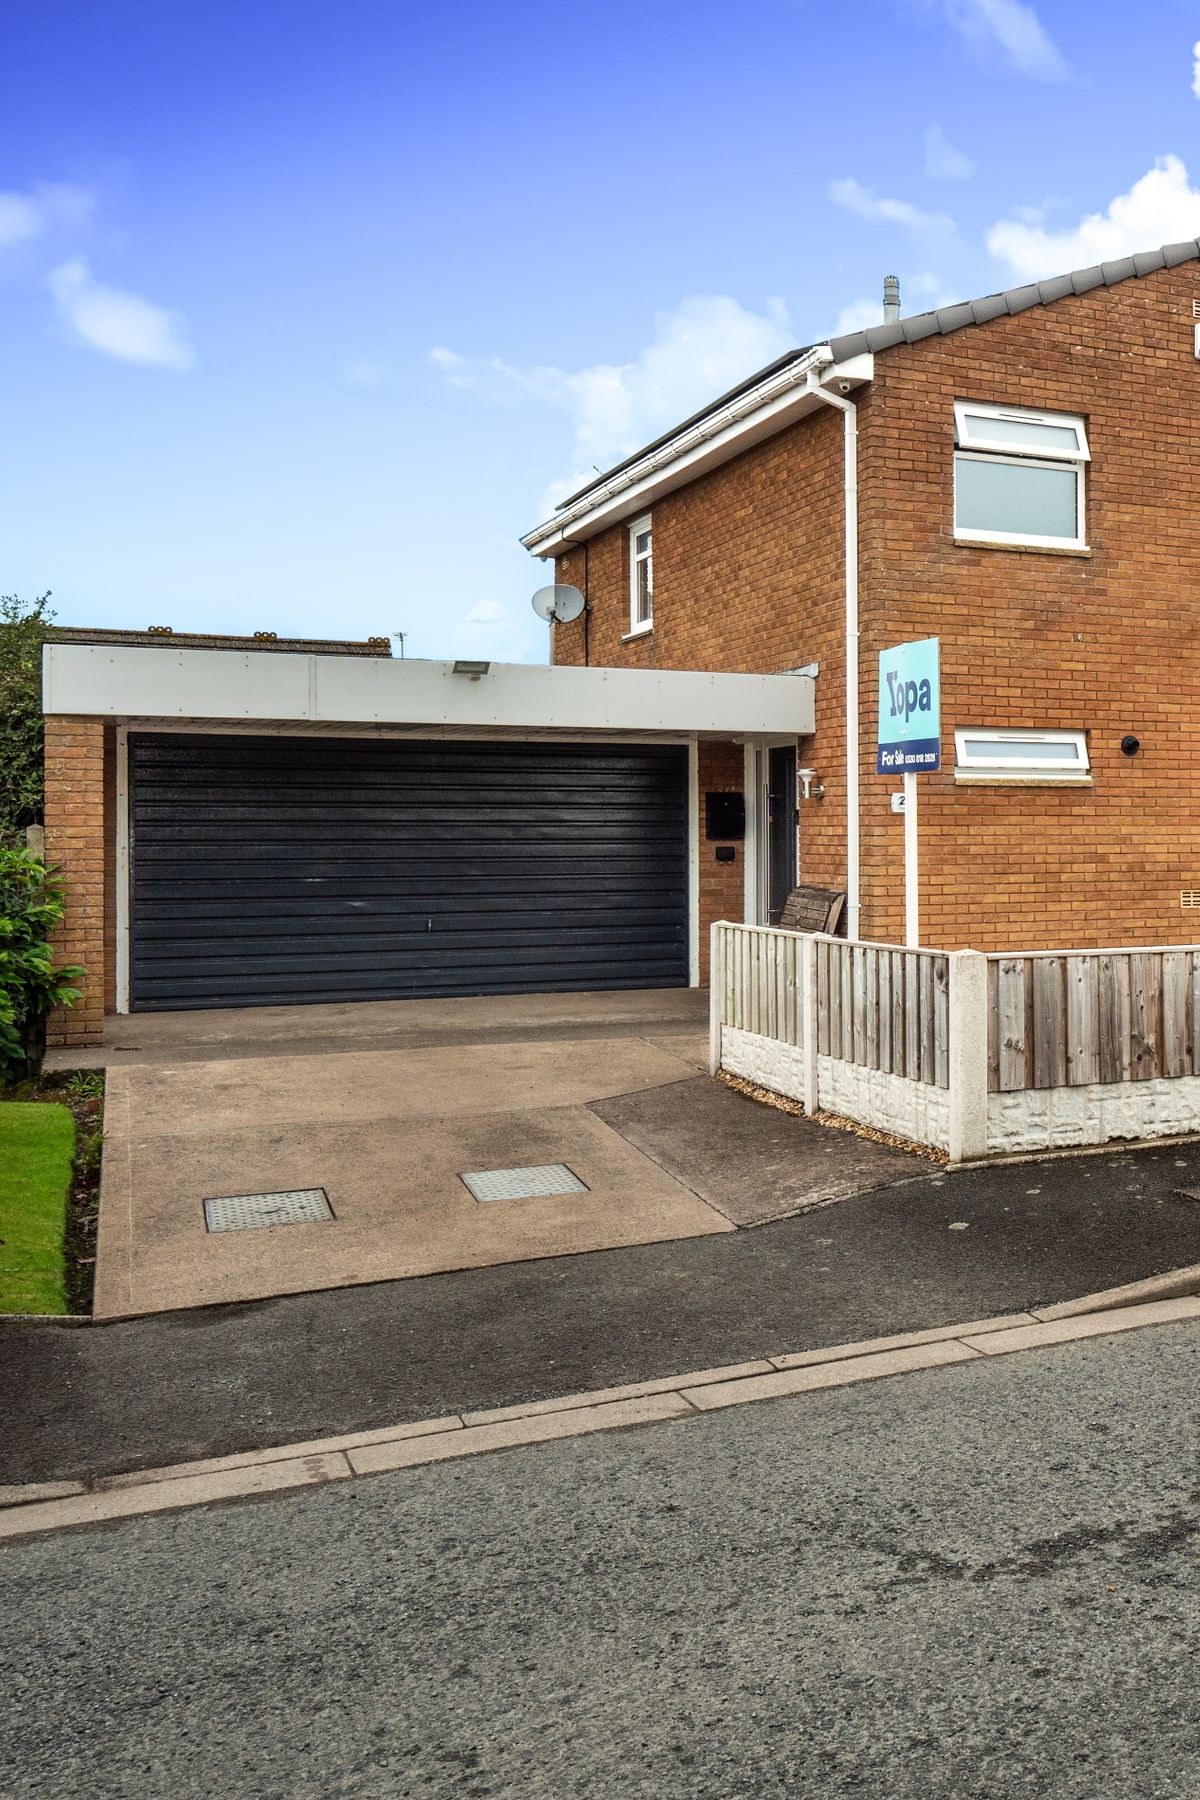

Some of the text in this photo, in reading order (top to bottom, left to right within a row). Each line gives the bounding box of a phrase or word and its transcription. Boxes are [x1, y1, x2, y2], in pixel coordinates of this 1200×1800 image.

[886, 670, 931, 723] Yopa
[882, 751, 894, 766] For
[895, 749, 904, 765] Sale
